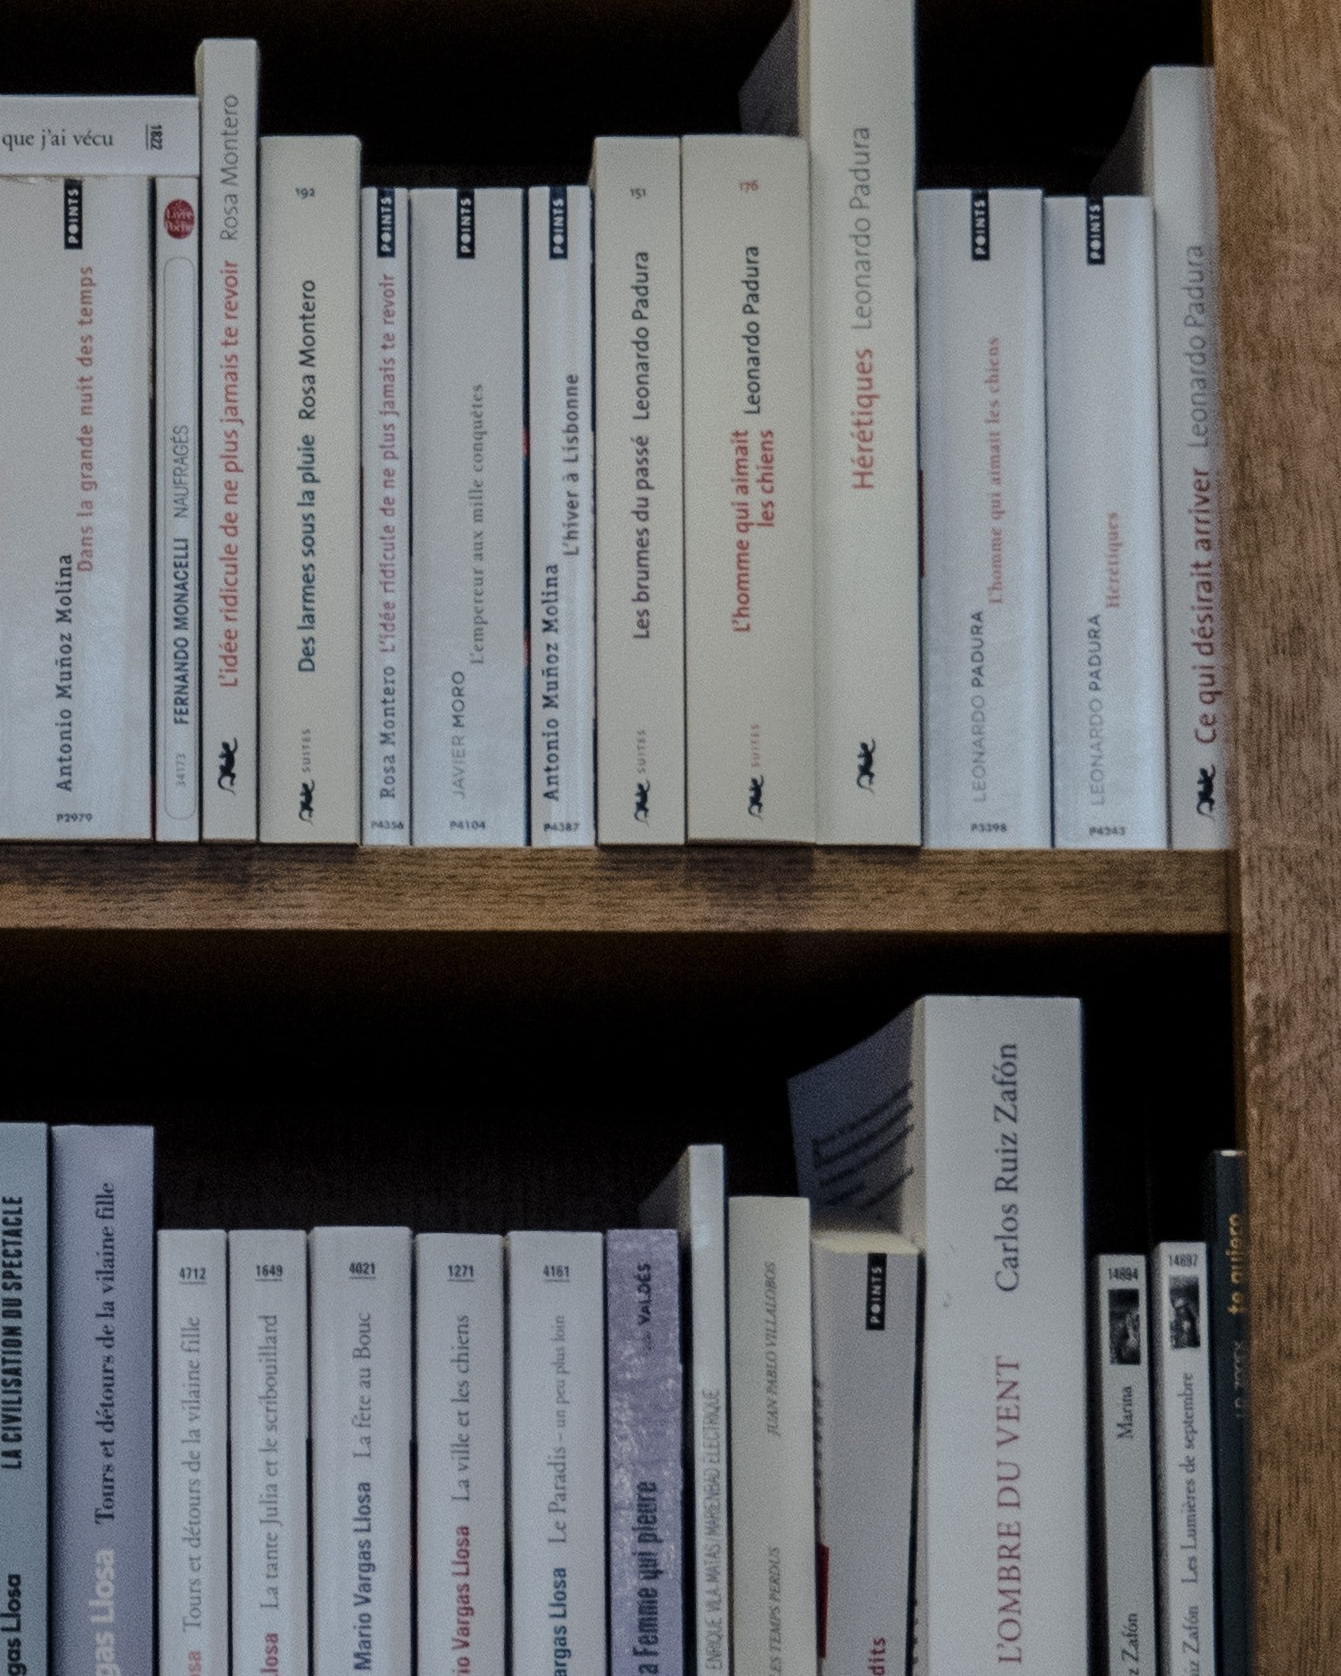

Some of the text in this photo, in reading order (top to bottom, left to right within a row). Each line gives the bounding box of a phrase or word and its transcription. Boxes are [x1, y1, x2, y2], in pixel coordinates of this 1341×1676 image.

[2, 134, 34, 152] que
[73, 130, 113, 146] vécu
[76, 266, 98, 572] Dans la grande nuit des temps
[631, 251, 655, 639] Les brumes du passé Leonardo Padura
[55, 554, 73, 792] Antonio Muñoz Molina
[173, 539, 189, 724] FERNANDO MONACELLI
[992, 1044, 1018, 1123] Zafón
[994, 1133, 1018, 1193] Ruiz
[994, 1203, 1019, 1292] Carlos
[1, 1197, 23, 1469] LA CIVILISATION DU SPECTACLE
[996, 1356, 1020, 1448] VENT
[352, 1313, 376, 1671] Mario Vargas Llosa La fête au Bouc
[997, 1460, 1021, 1509] DU
